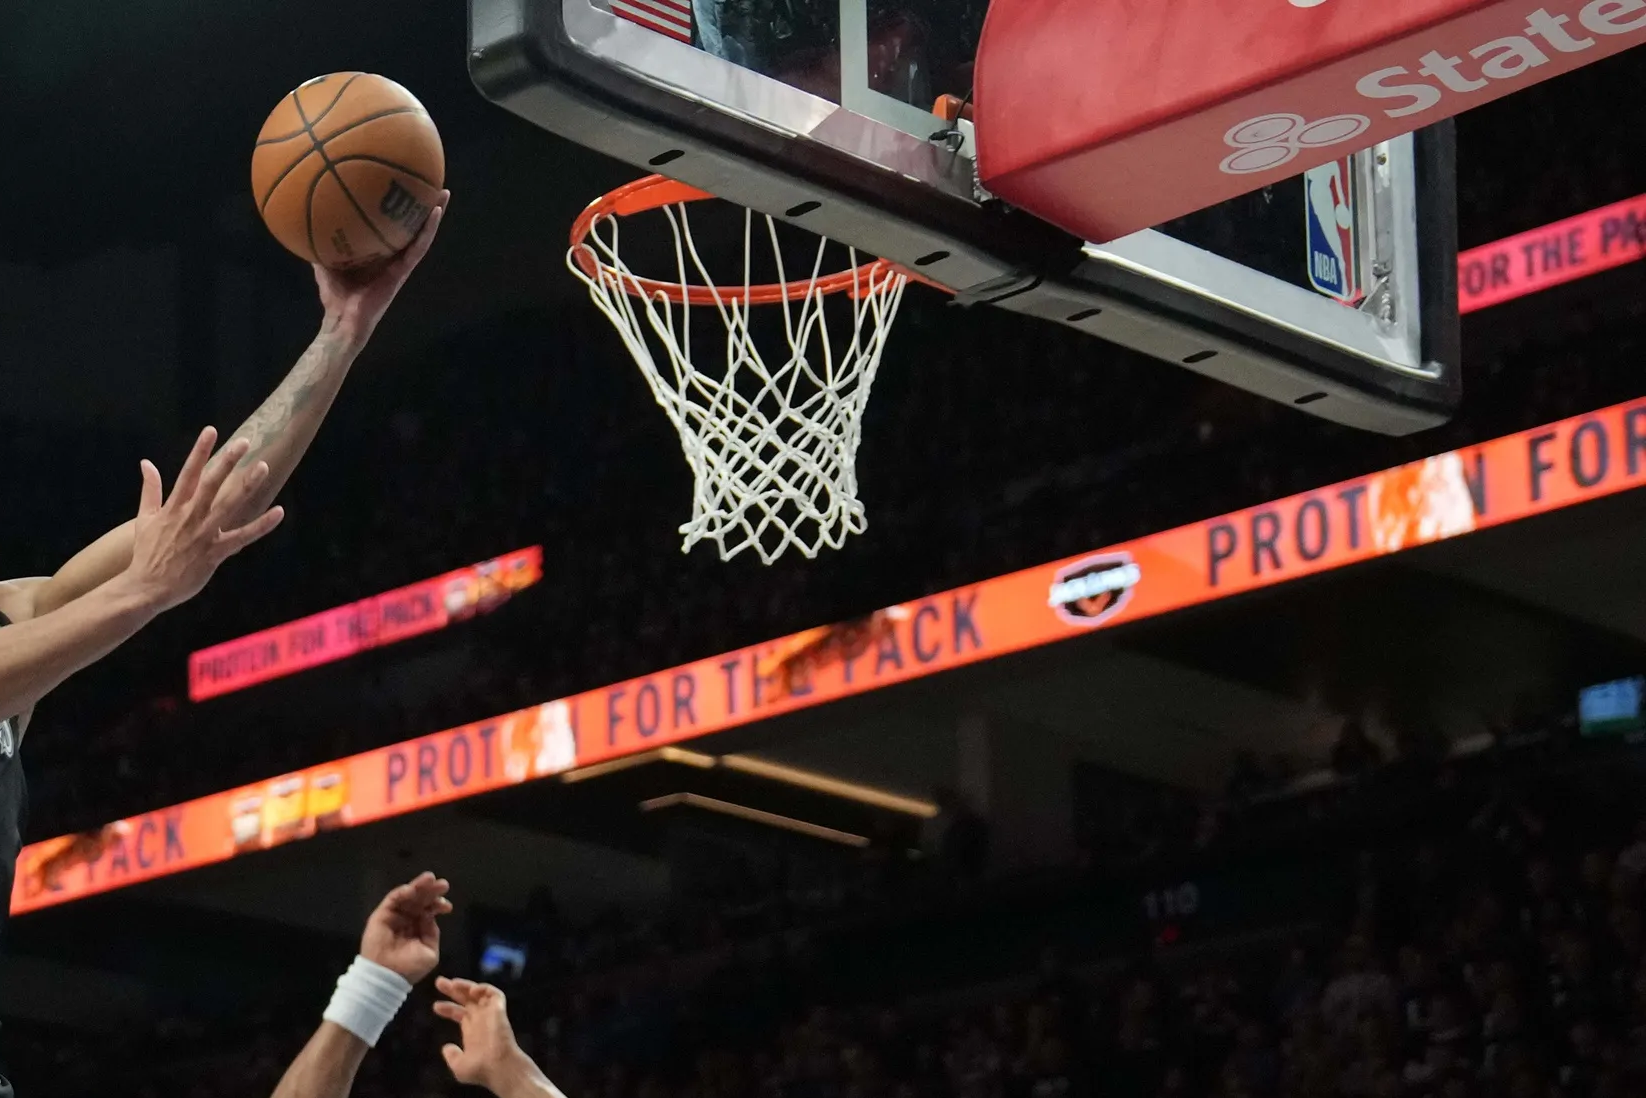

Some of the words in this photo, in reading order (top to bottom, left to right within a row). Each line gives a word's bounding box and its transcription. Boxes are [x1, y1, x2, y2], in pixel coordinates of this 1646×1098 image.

[1355, 0, 1646, 117] State
[1312, 249, 1338, 286] NBA
[1522, 226, 1586, 278] THE
[1208, 451, 1487, 587] PROTN
[606, 673, 697, 747] FOR
[843, 590, 984, 684] ACK
[84, 814, 185, 883] ACK
